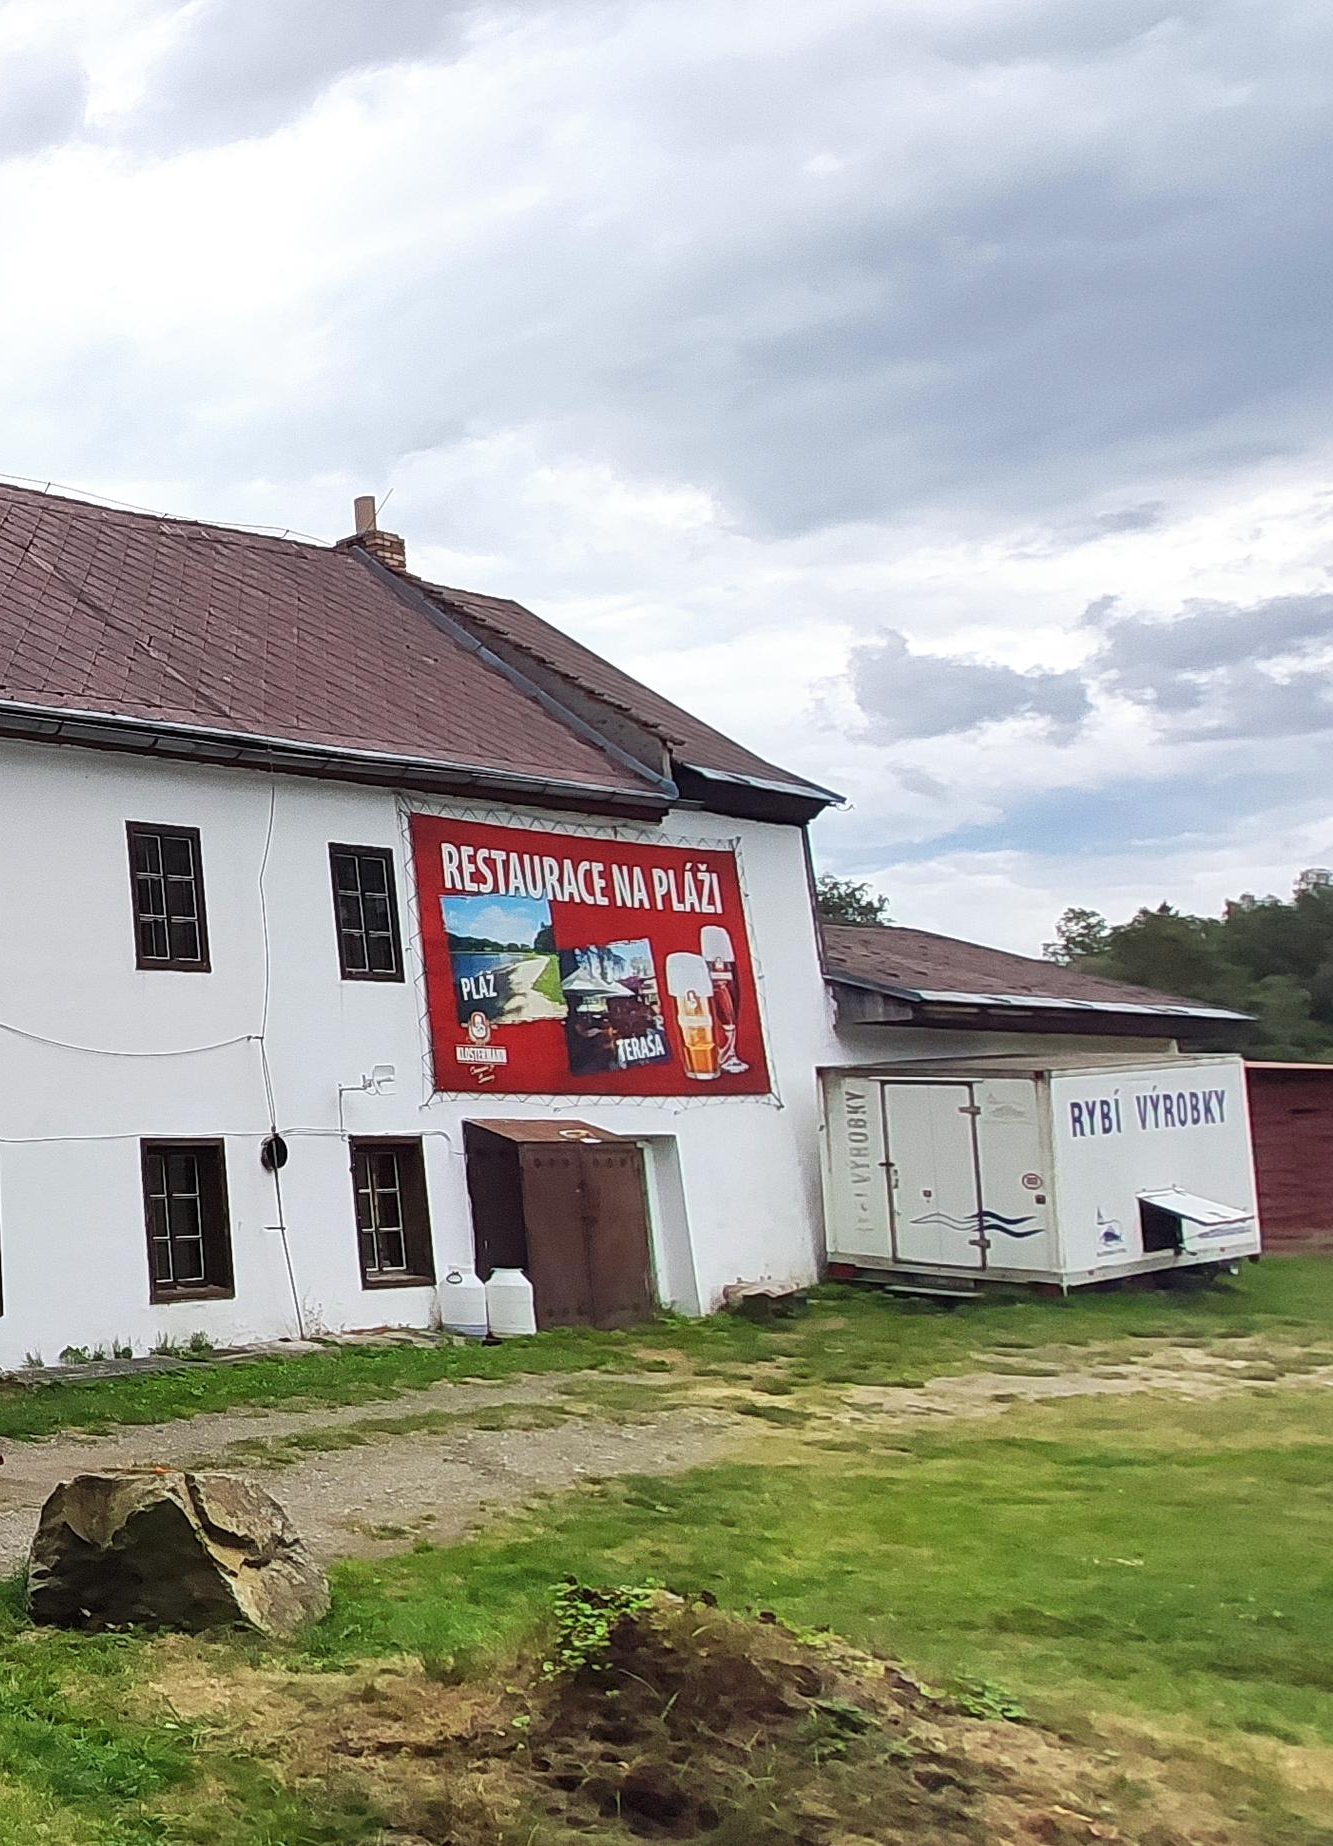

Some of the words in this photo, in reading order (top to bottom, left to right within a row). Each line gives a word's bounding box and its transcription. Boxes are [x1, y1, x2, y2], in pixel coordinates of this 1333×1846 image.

[441, 843, 610, 906] RESTAURACE
[611, 864, 650, 910] NA
[651, 863, 724, 914] PLÁŽI
[616, 1033, 666, 1062] TERASA
[1070, 1088, 1122, 1137] RYBÍ
[1136, 1085, 1226, 1130] VÝROBKY
